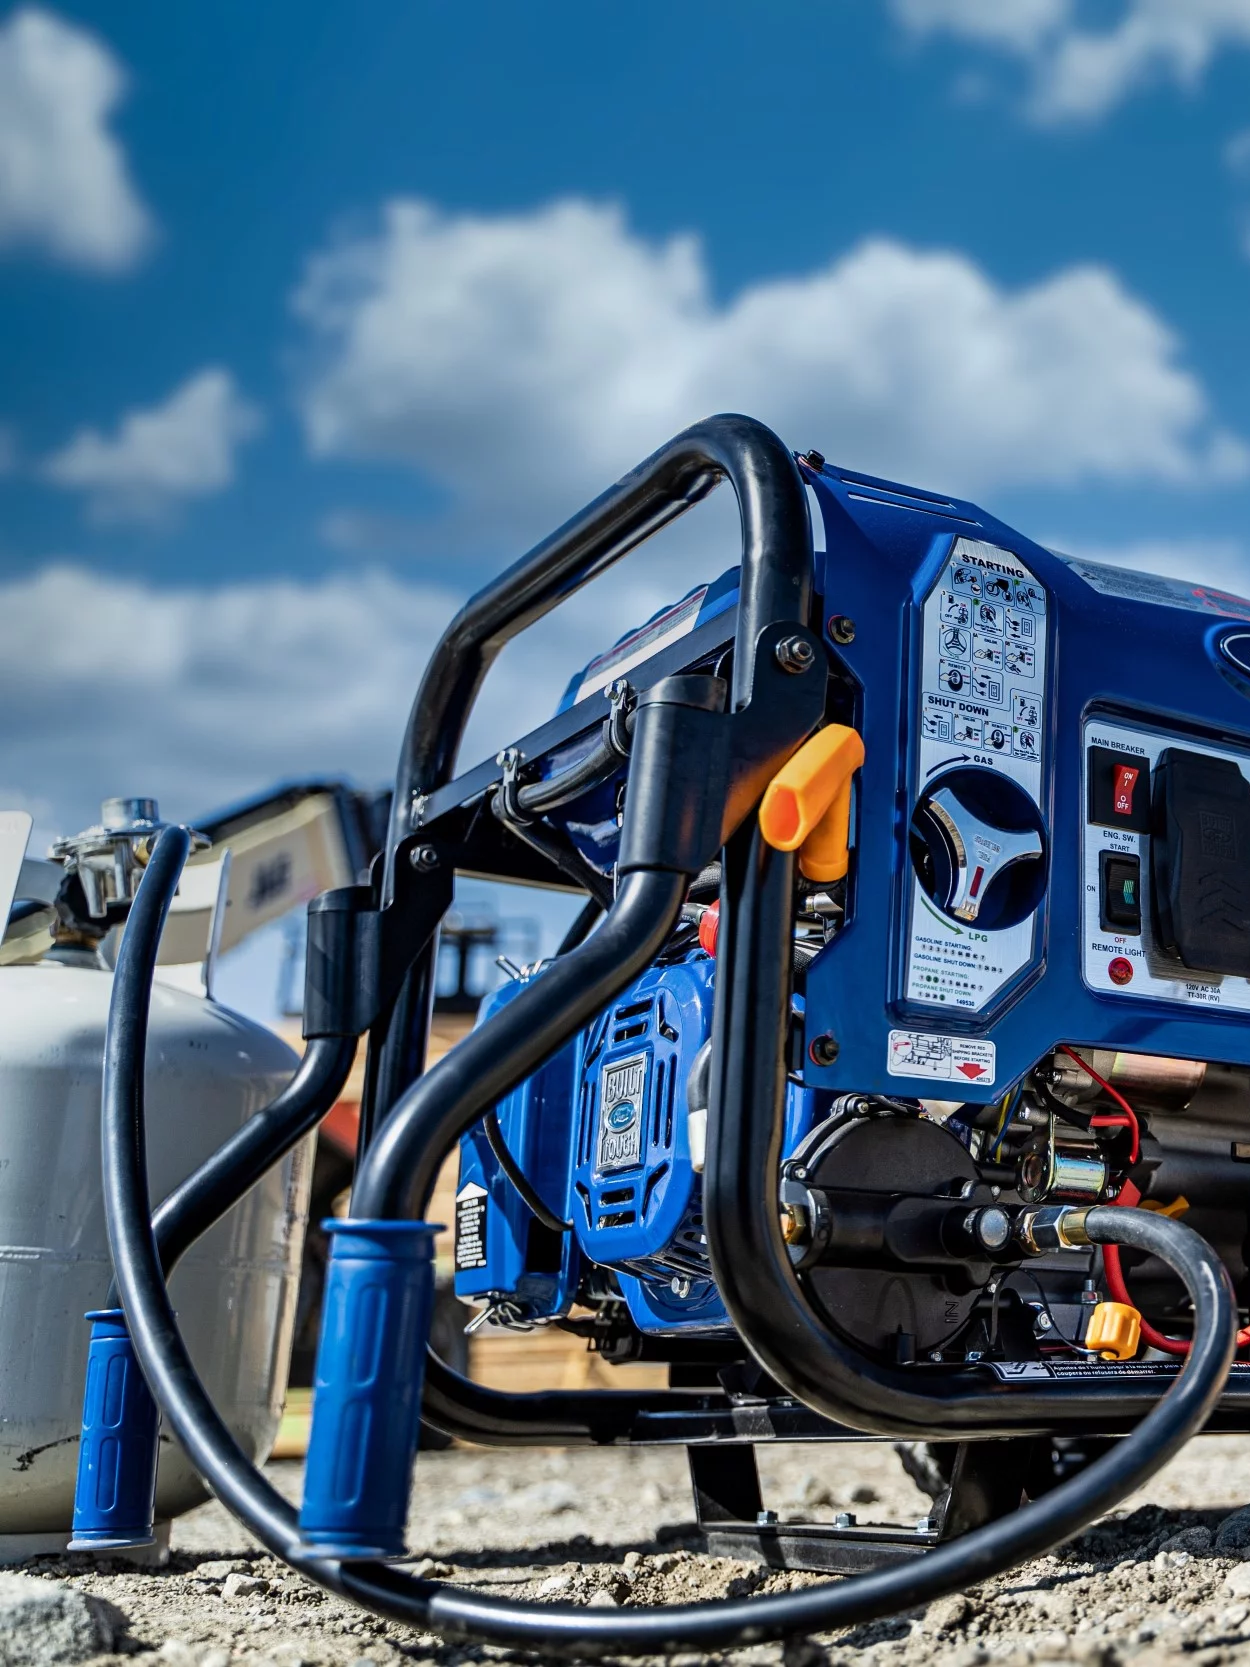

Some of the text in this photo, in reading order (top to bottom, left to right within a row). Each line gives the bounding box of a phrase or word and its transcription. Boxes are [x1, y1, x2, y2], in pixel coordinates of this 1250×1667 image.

[962, 554, 1024, 578] STARTING
[928, 696, 989, 717] SHUT DOWN
[1091, 737, 1145, 755] MAIN BREAKER
[973, 755, 994, 765] GAS
[1124, 772, 1134, 780] ON
[1117, 801, 1129, 810] OFF
[1103, 830, 1136, 843] ENG. SW.
[1110, 843, 1130, 852] START
[1087, 884, 1096, 892] ON
[915, 936, 973, 951] GASOLINE STARTING:
[968, 932, 988, 943] LPG
[1114, 936, 1127, 944] OFF
[1092, 943, 1146, 958] REMOTE LIGHT
[914, 953, 942, 963] GASOLINE
[943, 958, 959, 967] SHUT
[913, 965, 970, 980] PROPANE STARTING:
[912, 982, 939, 992] PROPANE
[940, 986, 954, 994] SHUT
[1186, 983, 1199, 991] 120V
[1200, 985, 1209, 993] AC
[1188, 992, 1220, 1003] TT-30R (RV)
[952, 1049, 970, 1057] SHIPPING
[608, 1066, 643, 1103] BUILT
[603, 1134, 637, 1163] TOUGH
[945, 1301, 960, 1323] IN
